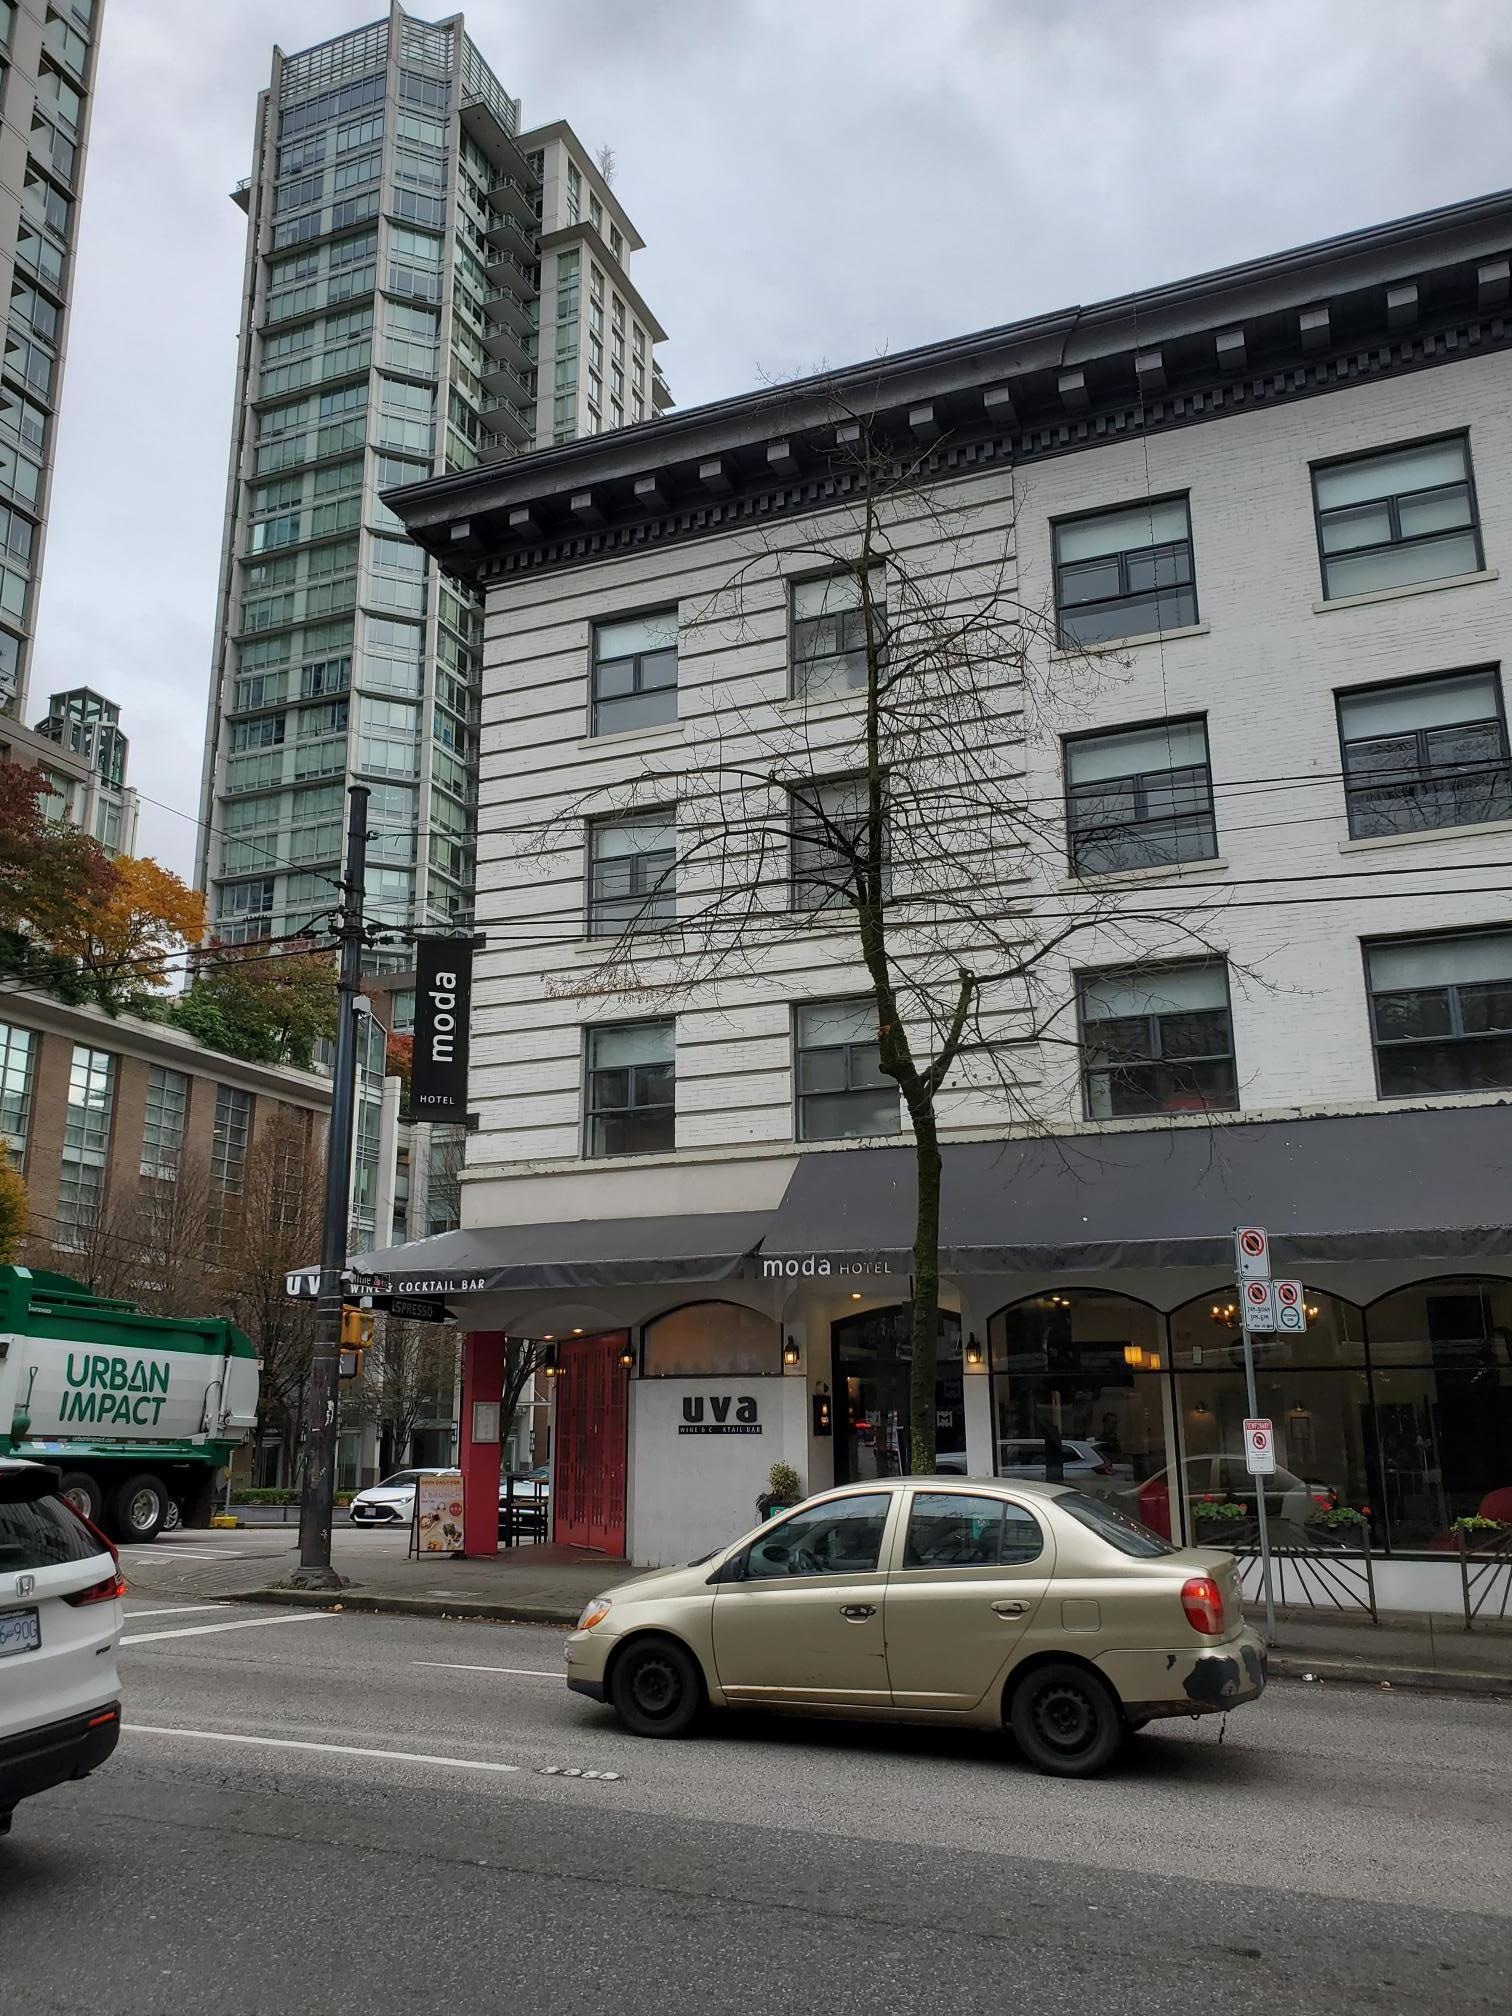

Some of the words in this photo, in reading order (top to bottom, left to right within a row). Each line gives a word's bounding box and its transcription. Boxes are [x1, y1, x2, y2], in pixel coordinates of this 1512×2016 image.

[429, 971, 457, 1062] moda
[420, 1095, 455, 1105] HOTEL
[763, 1254, 831, 1277] moda
[839, 1262, 892, 1275] HOTEL
[398, 1280, 455, 1292] COCKTAIL
[461, 1278, 486, 1290] BAR
[66, 1353, 170, 1394] URBAN
[59, 1390, 167, 1426] IMPACT
[683, 1396, 757, 1423] uva
